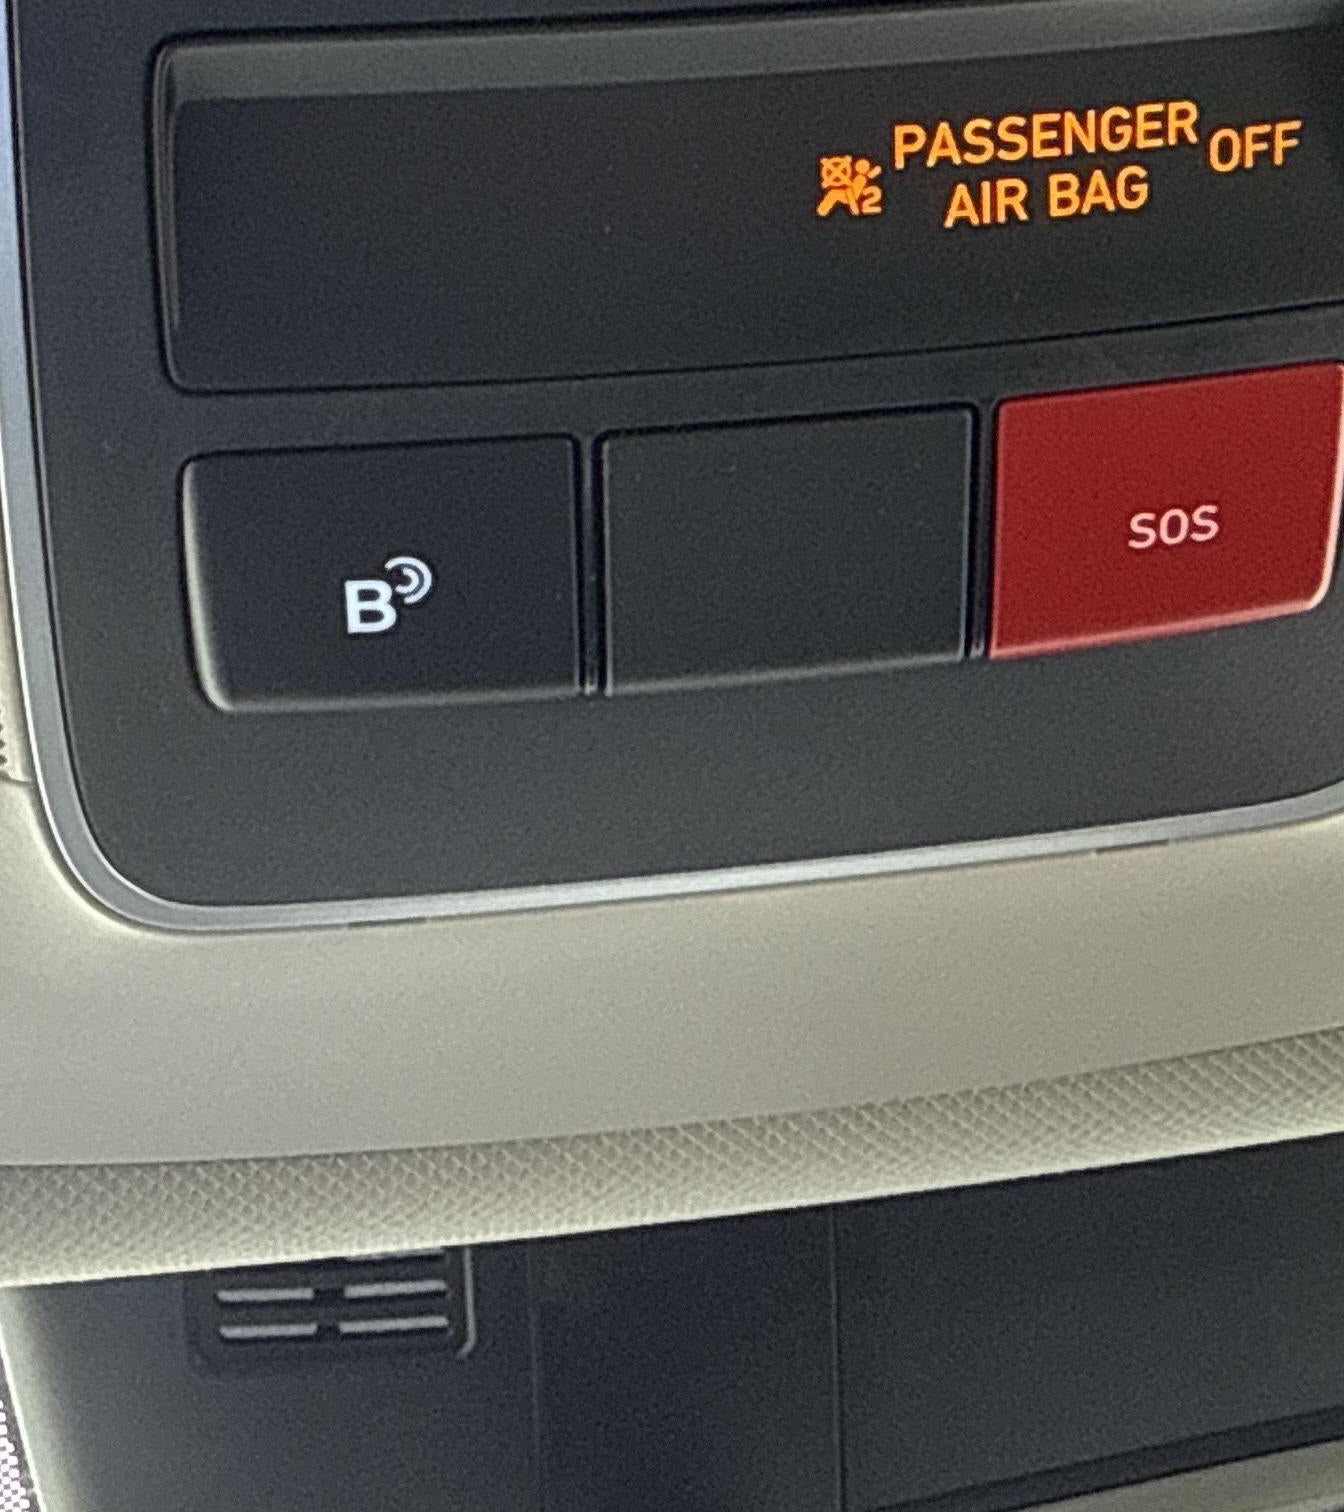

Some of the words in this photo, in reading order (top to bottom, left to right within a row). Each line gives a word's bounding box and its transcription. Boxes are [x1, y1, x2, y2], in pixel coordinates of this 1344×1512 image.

[893, 99, 1199, 170] PASSENGER
[1208, 119, 1303, 173] OFF
[942, 177, 1030, 229] AIR
[1047, 164, 1150, 219] BAG
[1127, 503, 1221, 551] SOS
[344, 579, 398, 635] B
